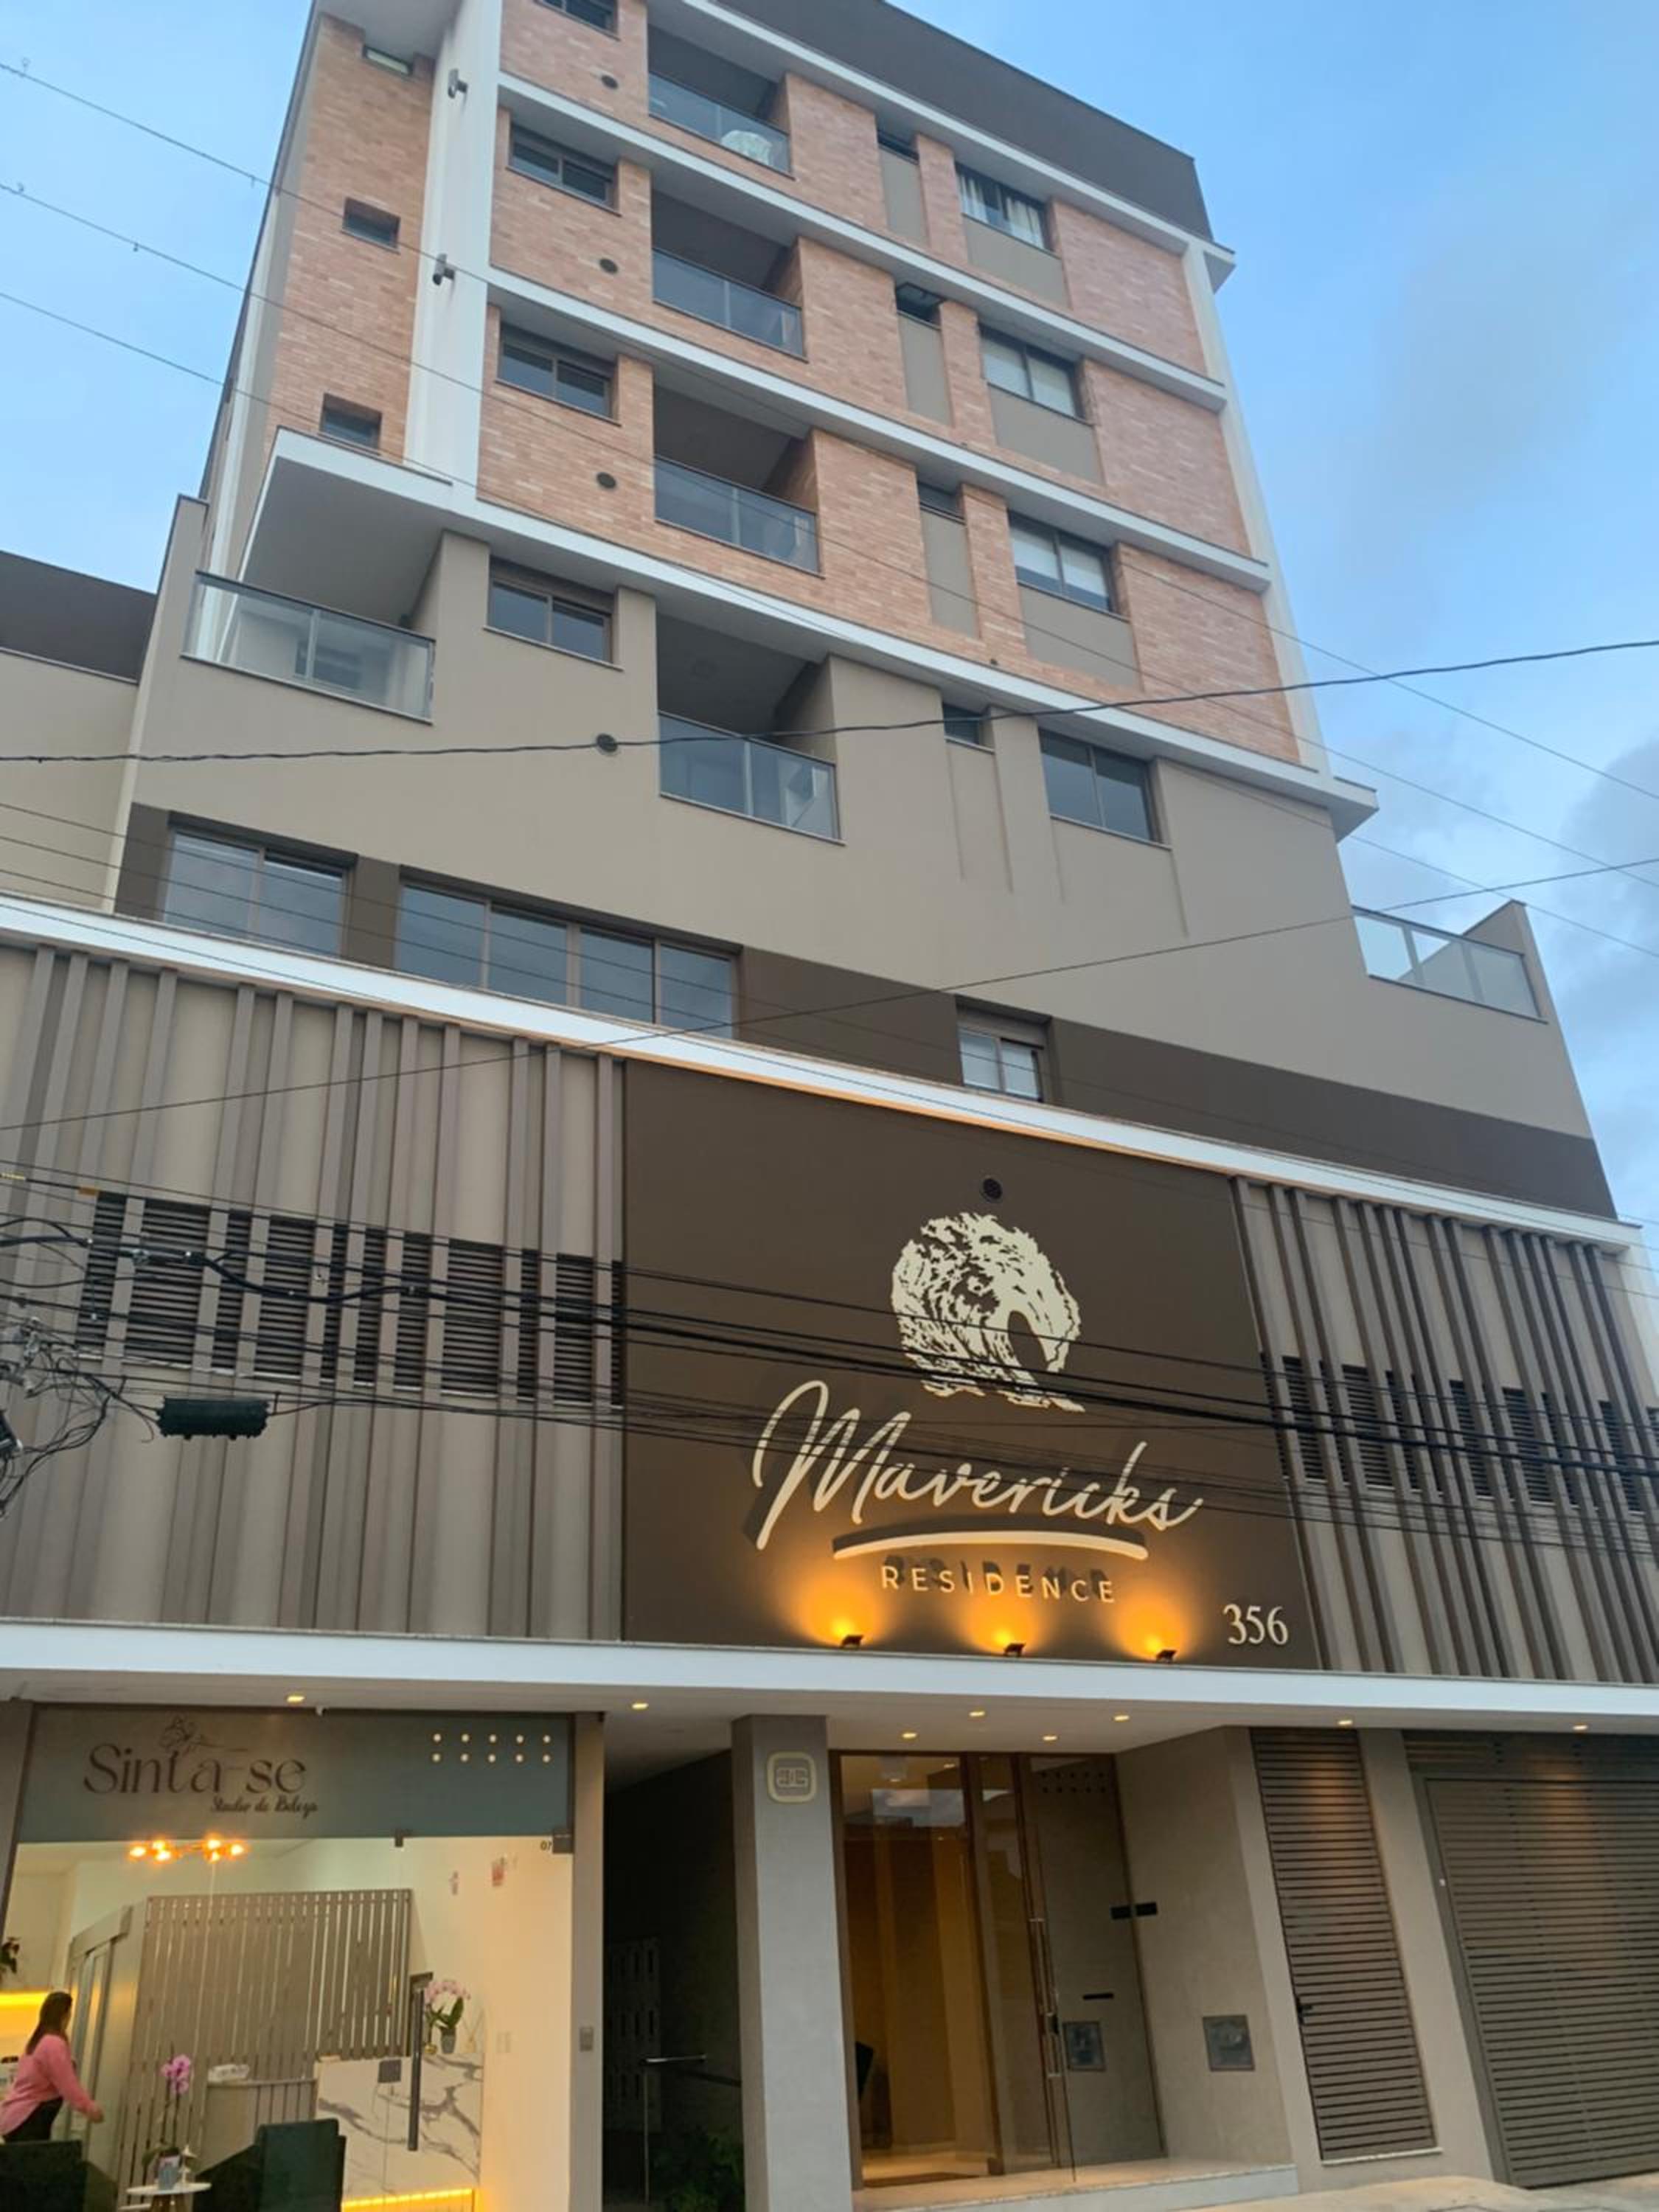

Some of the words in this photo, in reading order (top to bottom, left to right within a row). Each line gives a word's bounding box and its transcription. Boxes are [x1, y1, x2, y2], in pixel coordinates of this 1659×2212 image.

[752, 1380, 1203, 1551] Mavericks
[880, 1565, 1116, 1604] RESIDENCE
[1222, 1602, 1290, 1646] 356
[83, 1743, 307, 1794] Sinta-se
